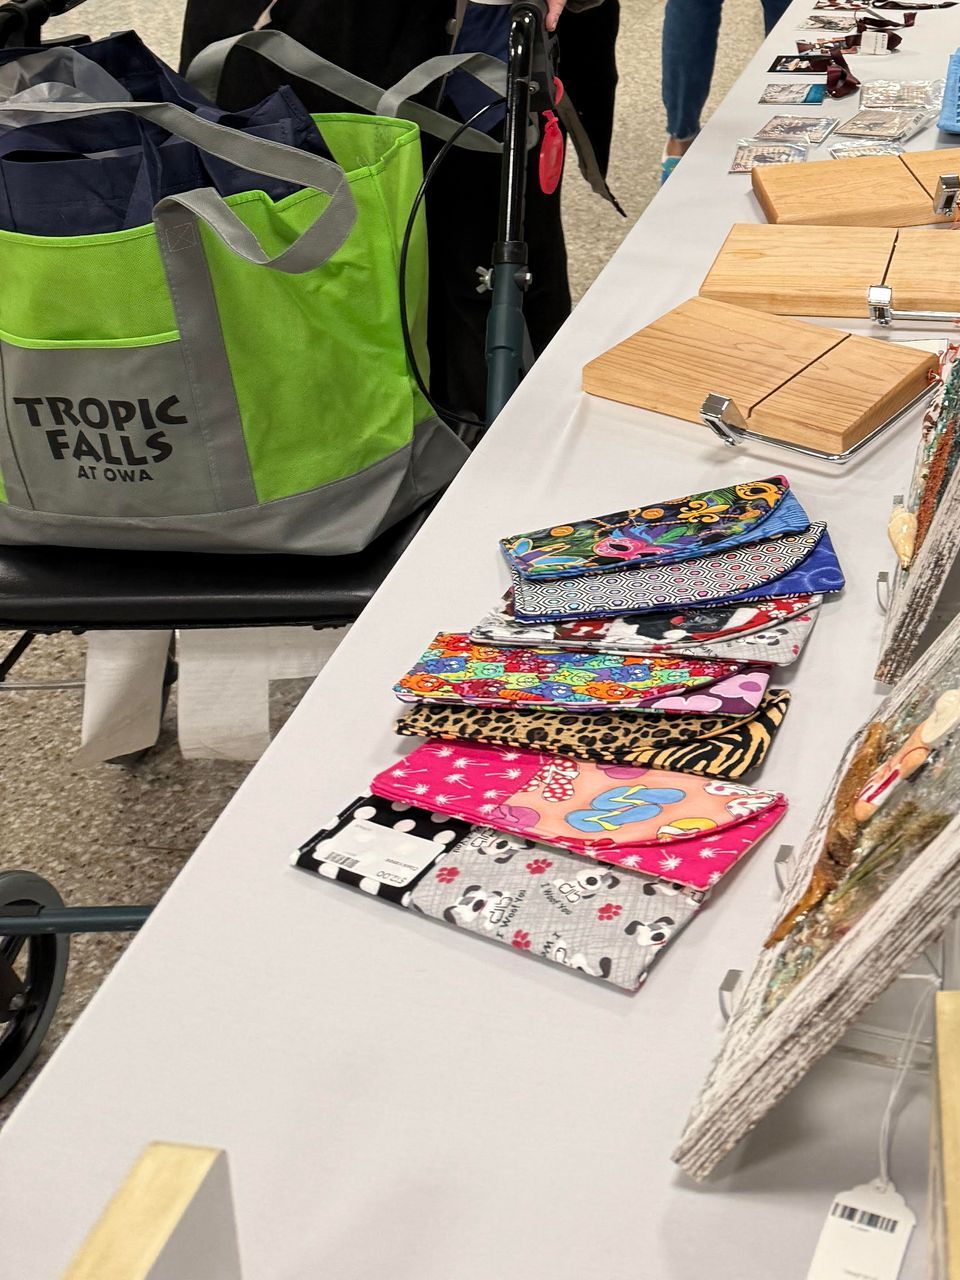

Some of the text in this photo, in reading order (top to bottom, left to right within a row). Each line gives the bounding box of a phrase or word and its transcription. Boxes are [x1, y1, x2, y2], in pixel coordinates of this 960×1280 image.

[13, 394, 188, 432] TROPIC
[45, 429, 174, 466] FALLS
[77, 465, 154, 483] AT OWA
[543, 887, 565, 905] Woof
[557, 903, 574, 915] You
[496, 931, 504, 940] I
